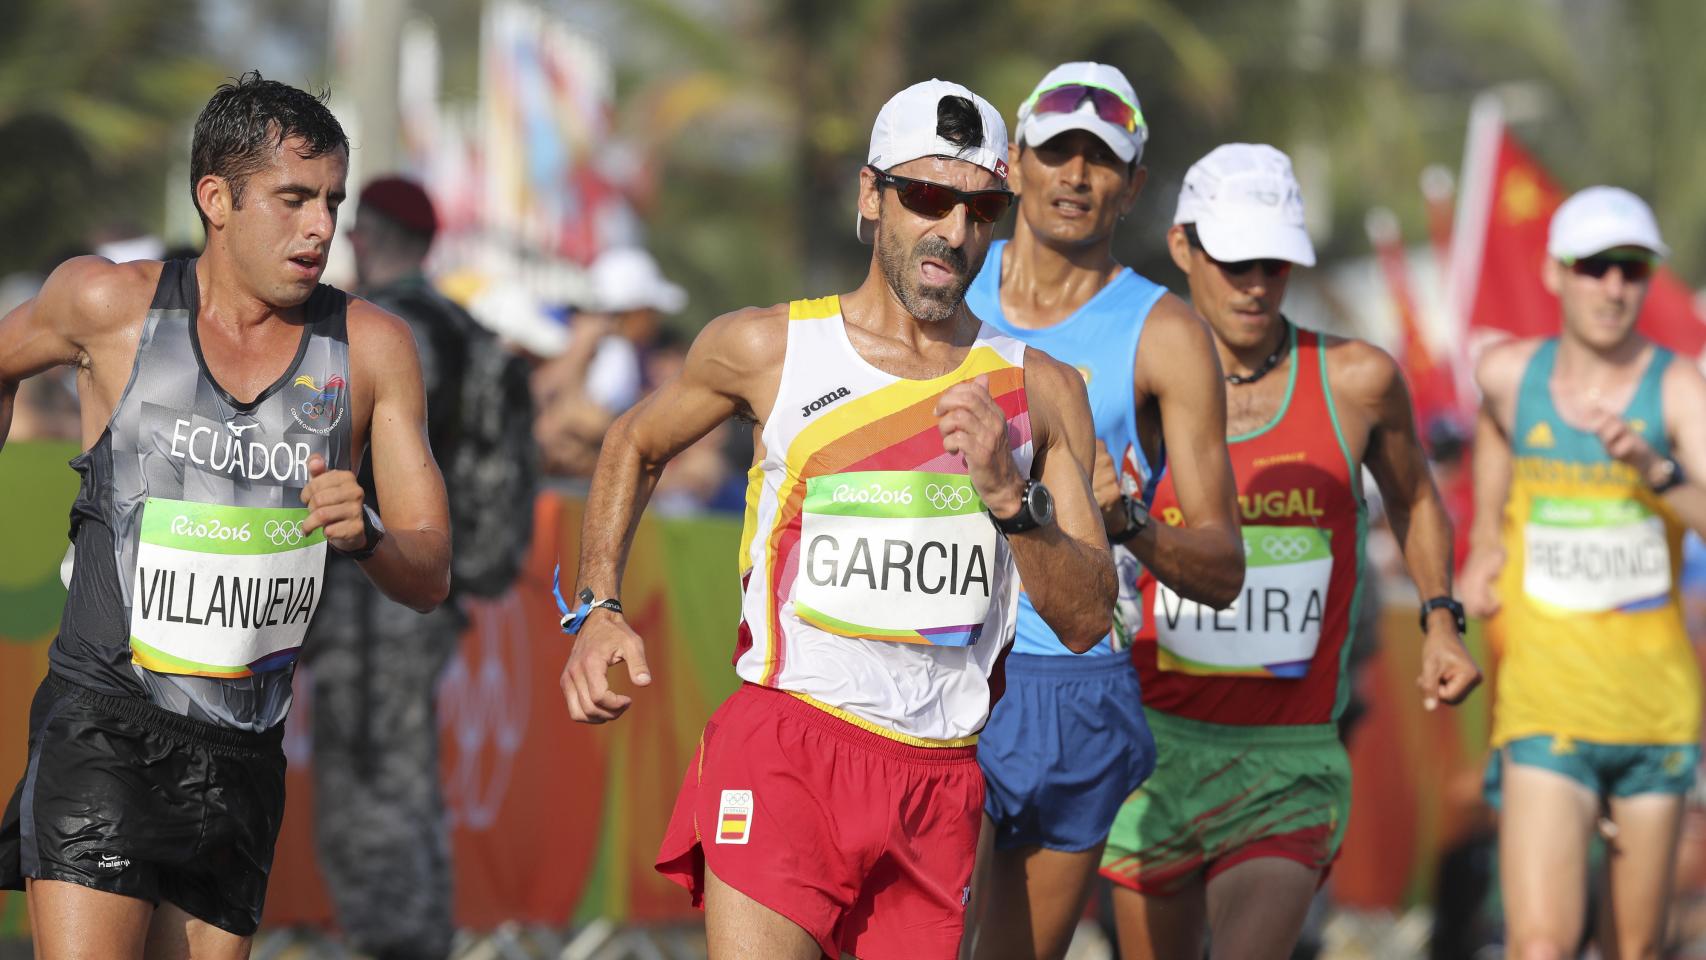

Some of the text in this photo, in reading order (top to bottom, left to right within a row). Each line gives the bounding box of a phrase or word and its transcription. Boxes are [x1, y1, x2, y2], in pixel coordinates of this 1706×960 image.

[170, 418, 311, 481] ECUADOR
[833, 484, 913, 505] Rio2016
[171, 514, 252, 542] Rio2016
[806, 534, 990, 597] GARCIA
[139, 566, 315, 629] VILLANUEVA
[98, 859, 131, 869] Kalenji
